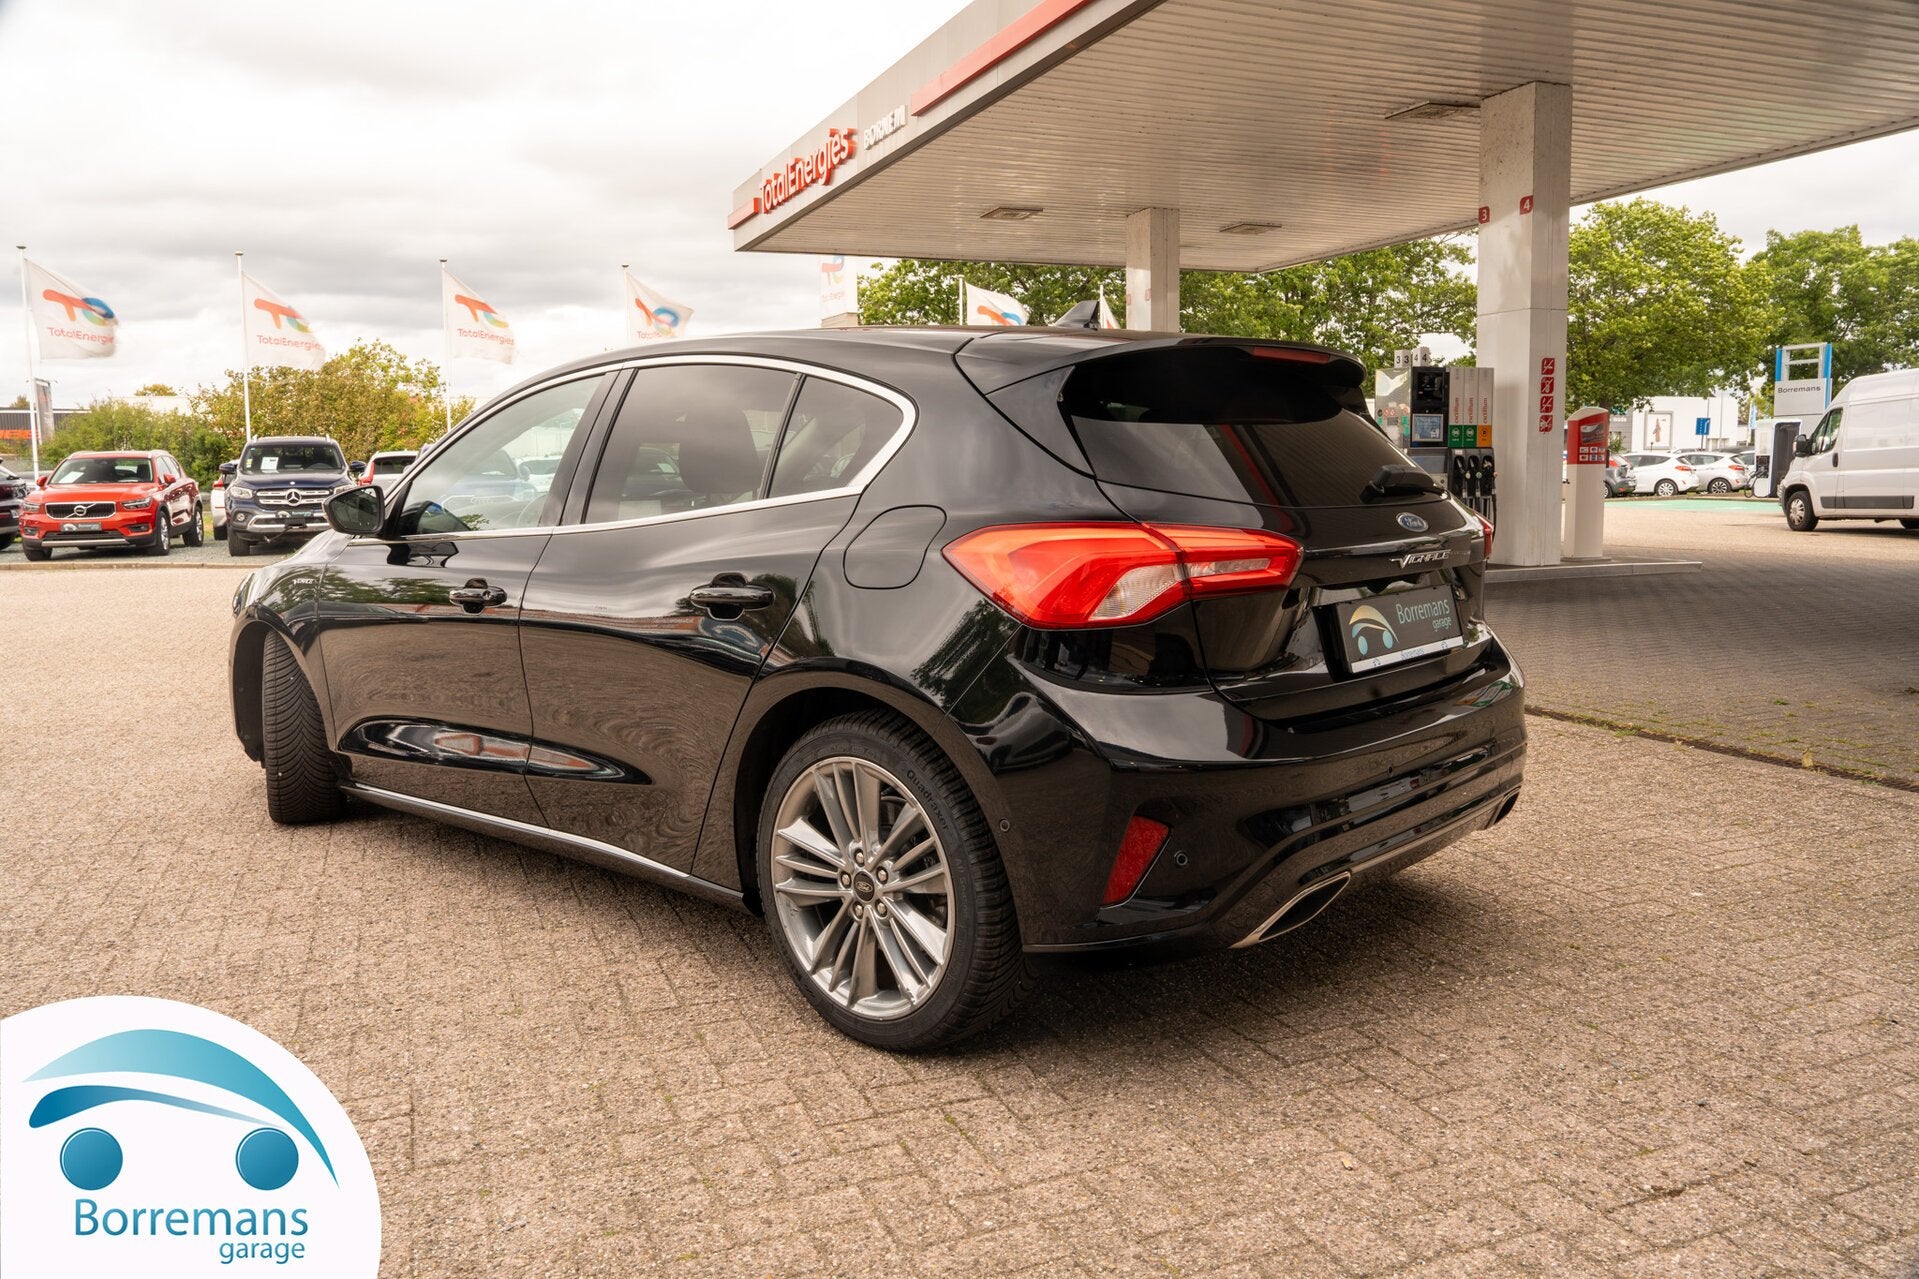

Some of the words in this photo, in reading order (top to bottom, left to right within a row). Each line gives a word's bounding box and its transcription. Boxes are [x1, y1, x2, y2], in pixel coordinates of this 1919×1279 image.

[863, 105, 907, 150] BORNEM
[761, 128, 856, 214] TotalEnergies
[1523, 199, 1530, 211] 4
[1481, 209, 1488, 221] 3
[1777, 385, 1821, 394] Borremans
[1396, 600, 1450, 624] Borremans
[1432, 617, 1452, 632] garage
[906, 769, 950, 831] Quadraxer
